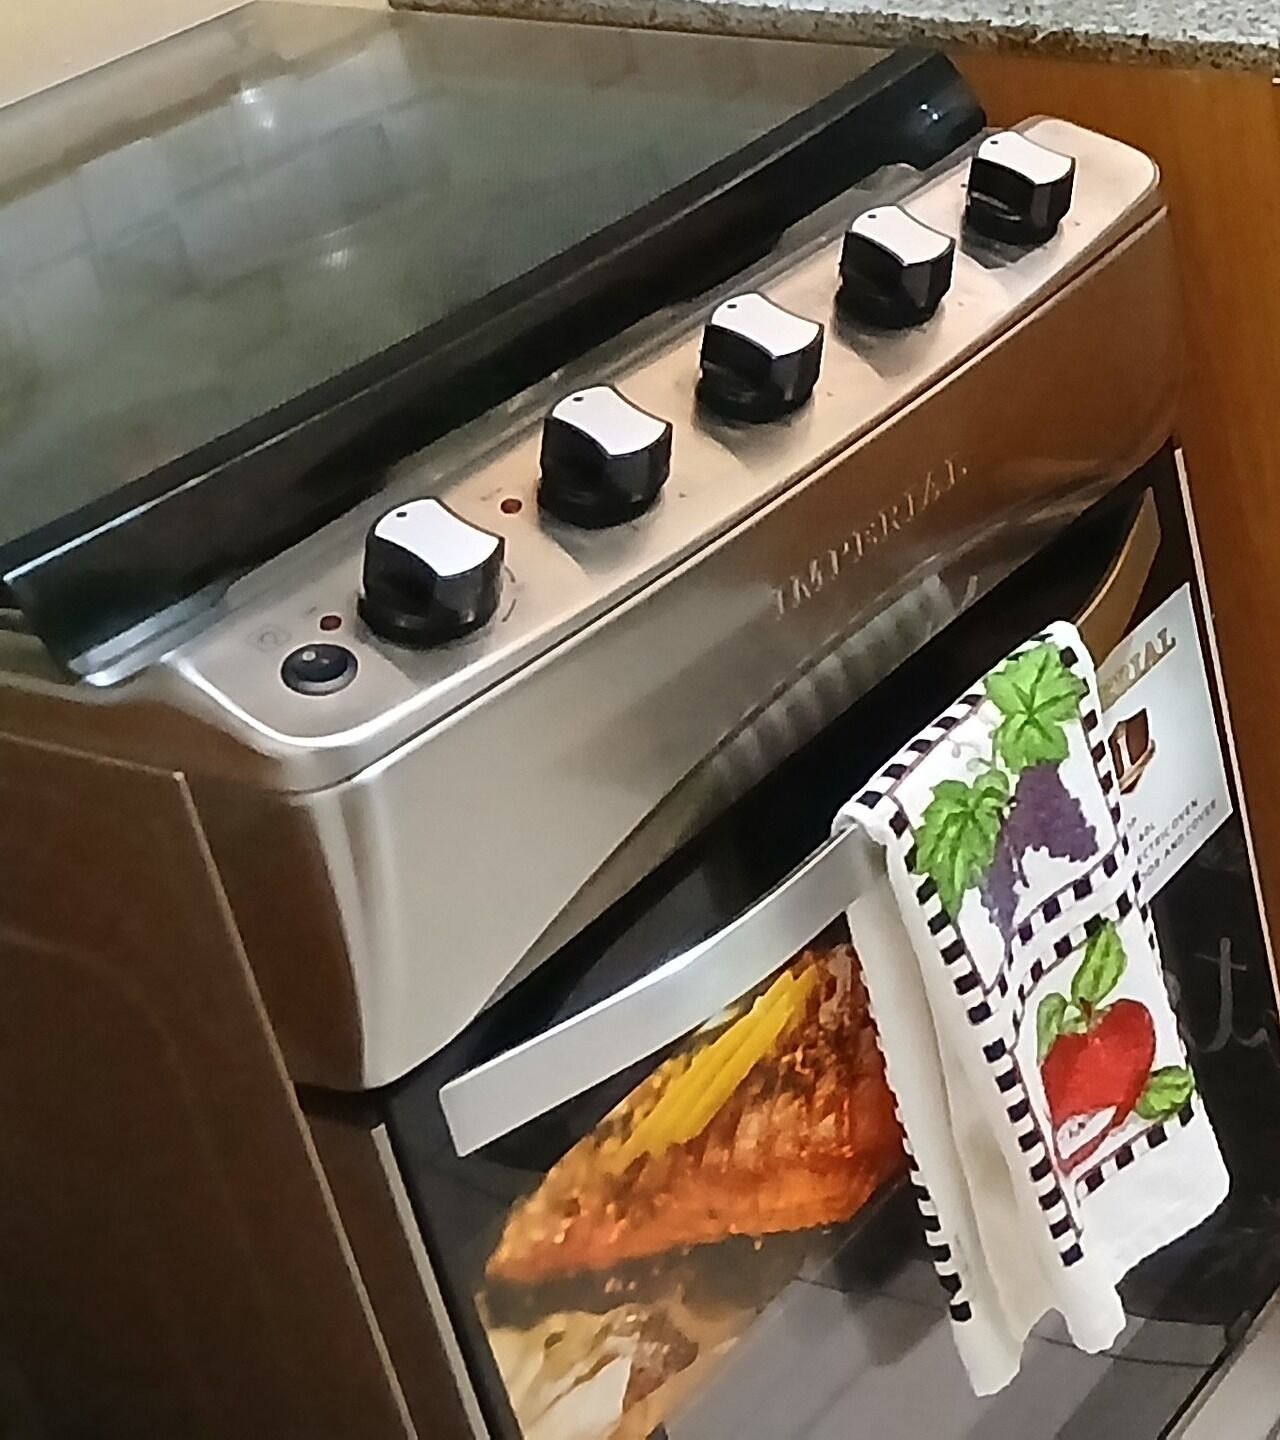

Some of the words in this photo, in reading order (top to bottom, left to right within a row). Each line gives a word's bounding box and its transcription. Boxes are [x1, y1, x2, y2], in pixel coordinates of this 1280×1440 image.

[771, 453, 968, 623] IMPERIAL
[1136, 826, 1170, 866] ECTRIC
[1171, 797, 1199, 830] OVEN
[1164, 833, 1185, 859] AND
[1185, 799, 1217, 836] COVER
